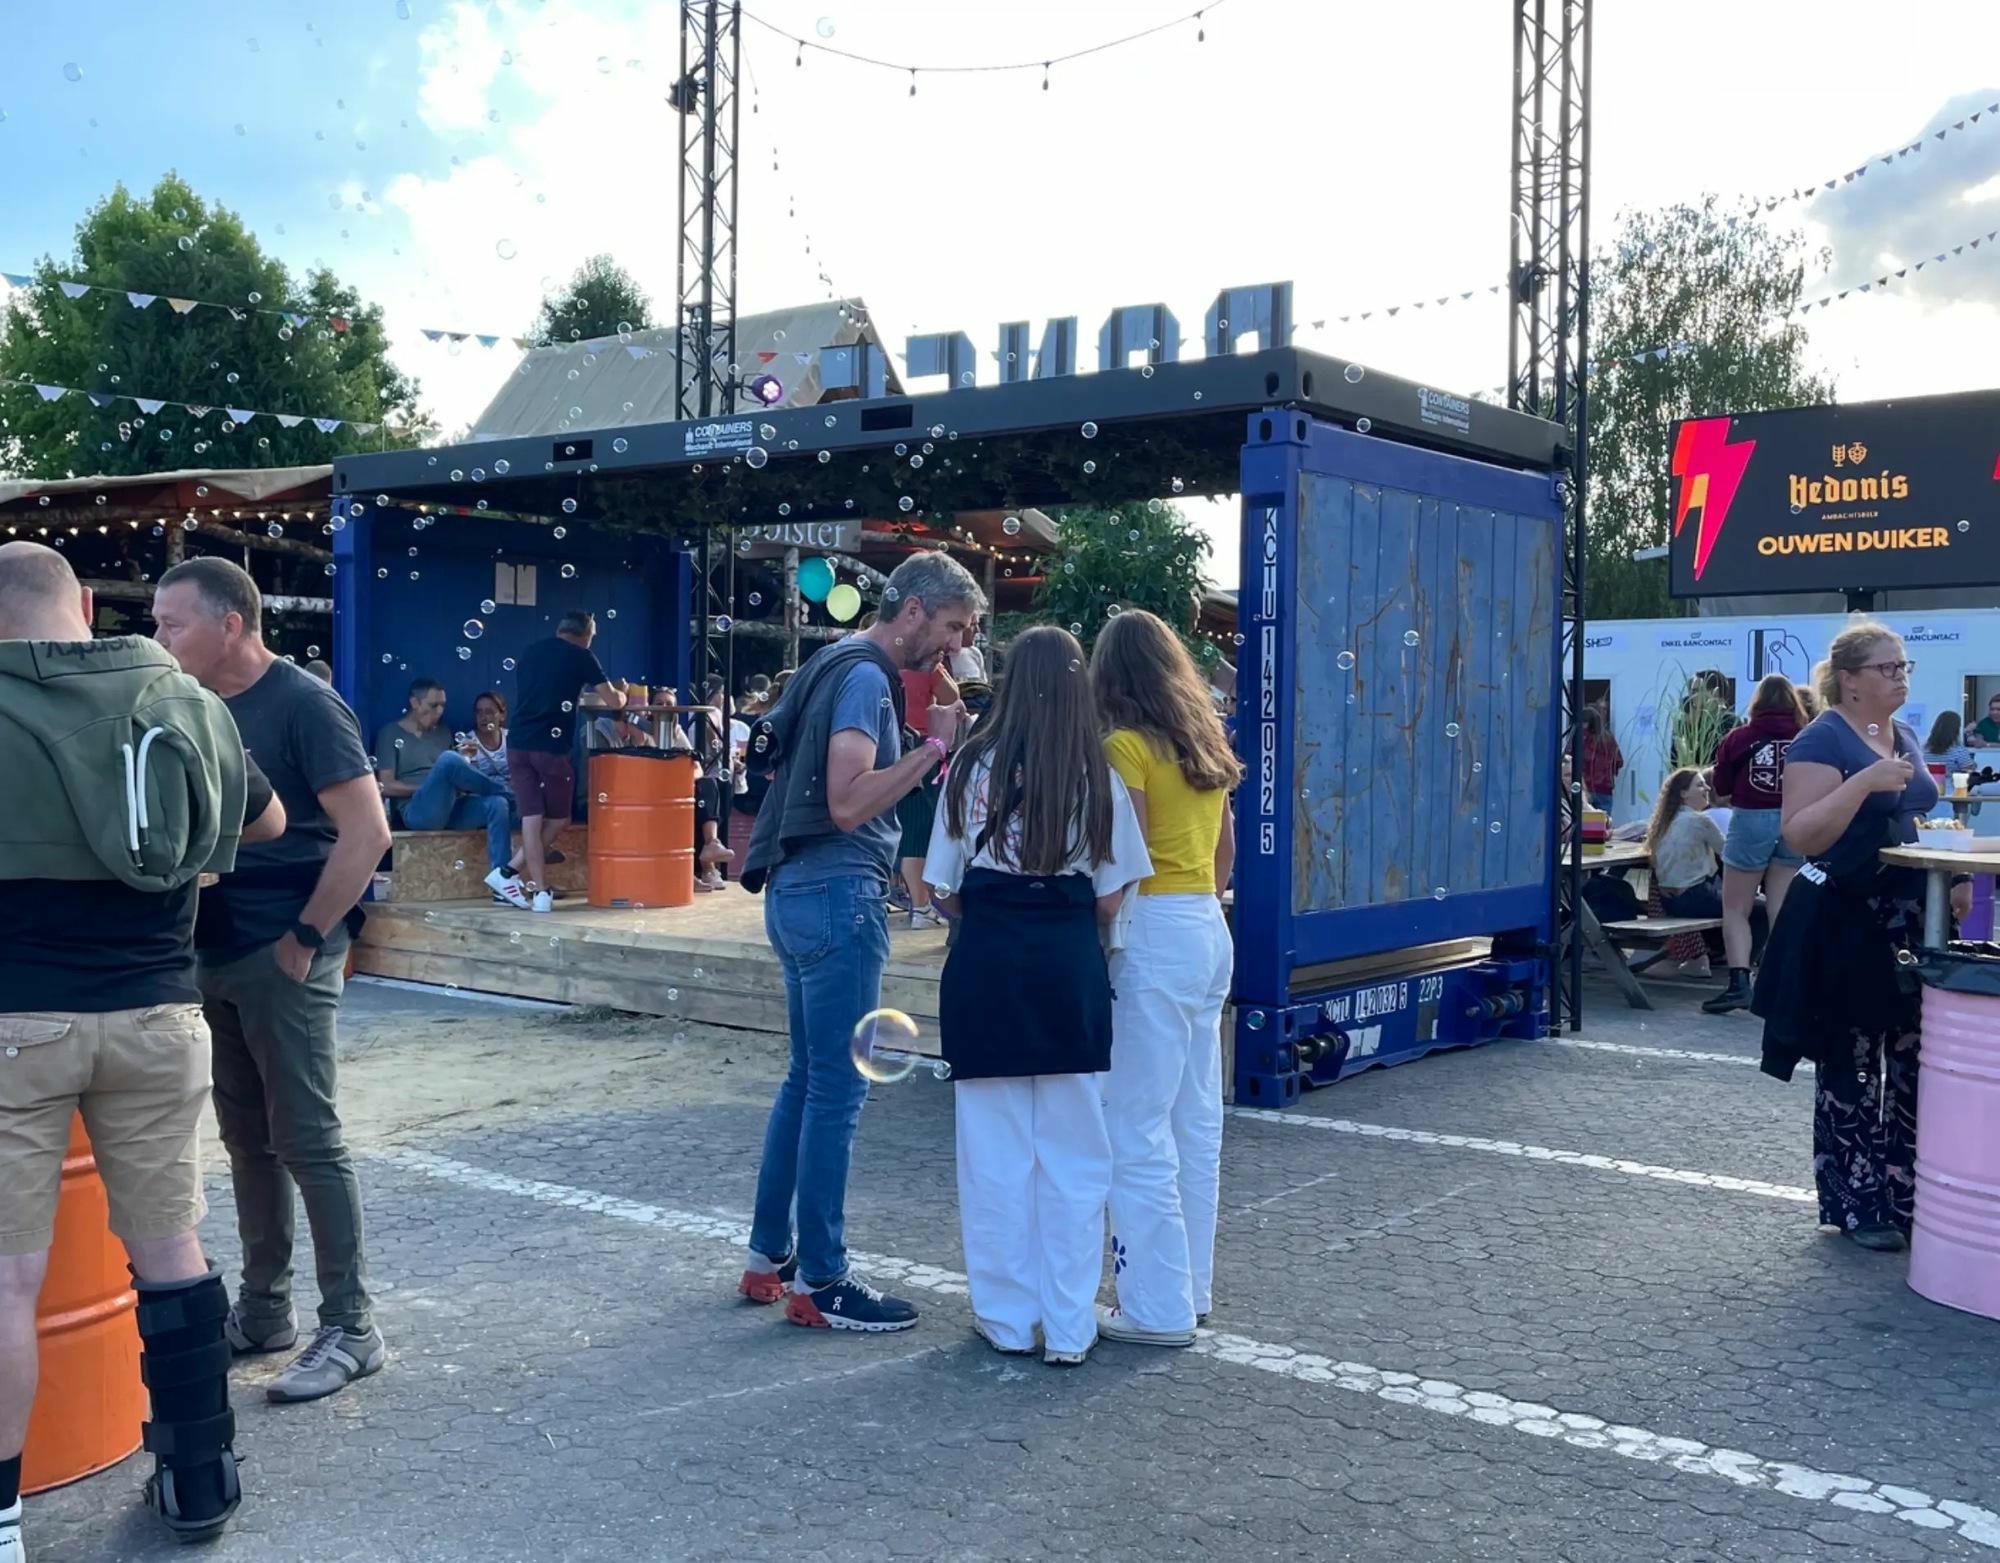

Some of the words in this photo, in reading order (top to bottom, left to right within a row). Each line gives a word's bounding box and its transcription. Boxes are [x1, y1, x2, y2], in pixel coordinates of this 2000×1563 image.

[1789, 470, 1908, 508] Hedonis
[1758, 532, 1853, 555] OUWEN
[1857, 527, 1950, 551] DUIKER
[1264, 508, 1277, 618] KCTU
[1683, 639, 1732, 647] BANCONTACT
[1904, 633, 1960, 642] BANCONTACT
[1418, 975, 1443, 1003] 22P3
